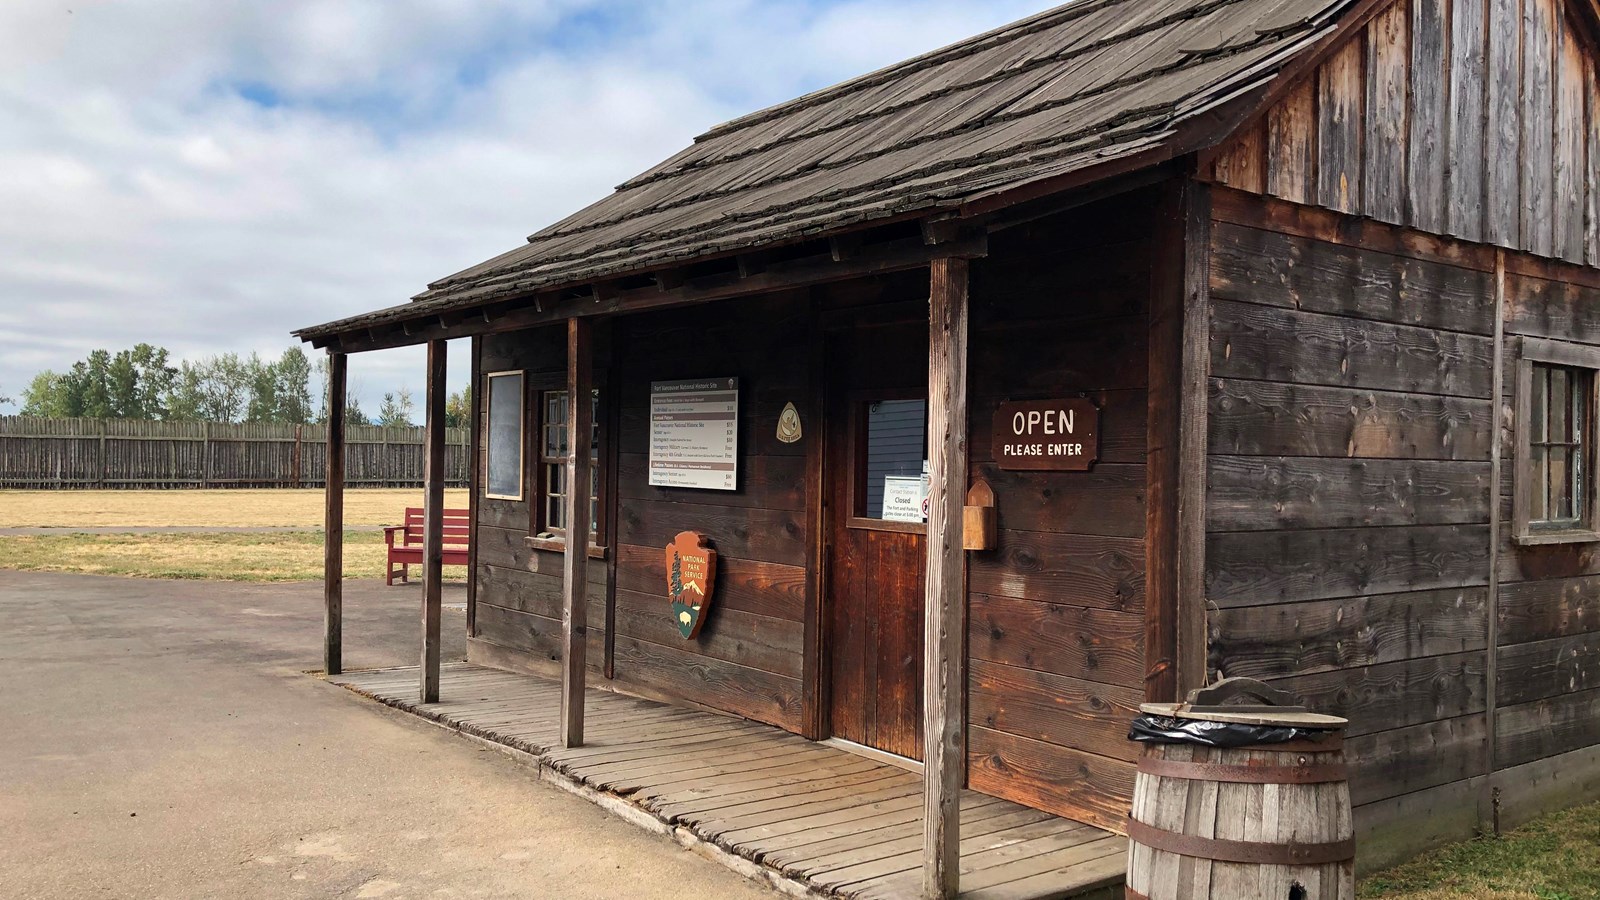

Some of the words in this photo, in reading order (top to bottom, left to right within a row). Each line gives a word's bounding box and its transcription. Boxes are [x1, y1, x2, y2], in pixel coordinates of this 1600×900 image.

[1012, 409, 1074, 435] OPEN
[1004, 444, 1042, 456] PLEASE
[1048, 443, 1082, 456] ENTER
[682, 555, 706, 563] NATIONAL
[684, 571, 703, 580] SERVICE
